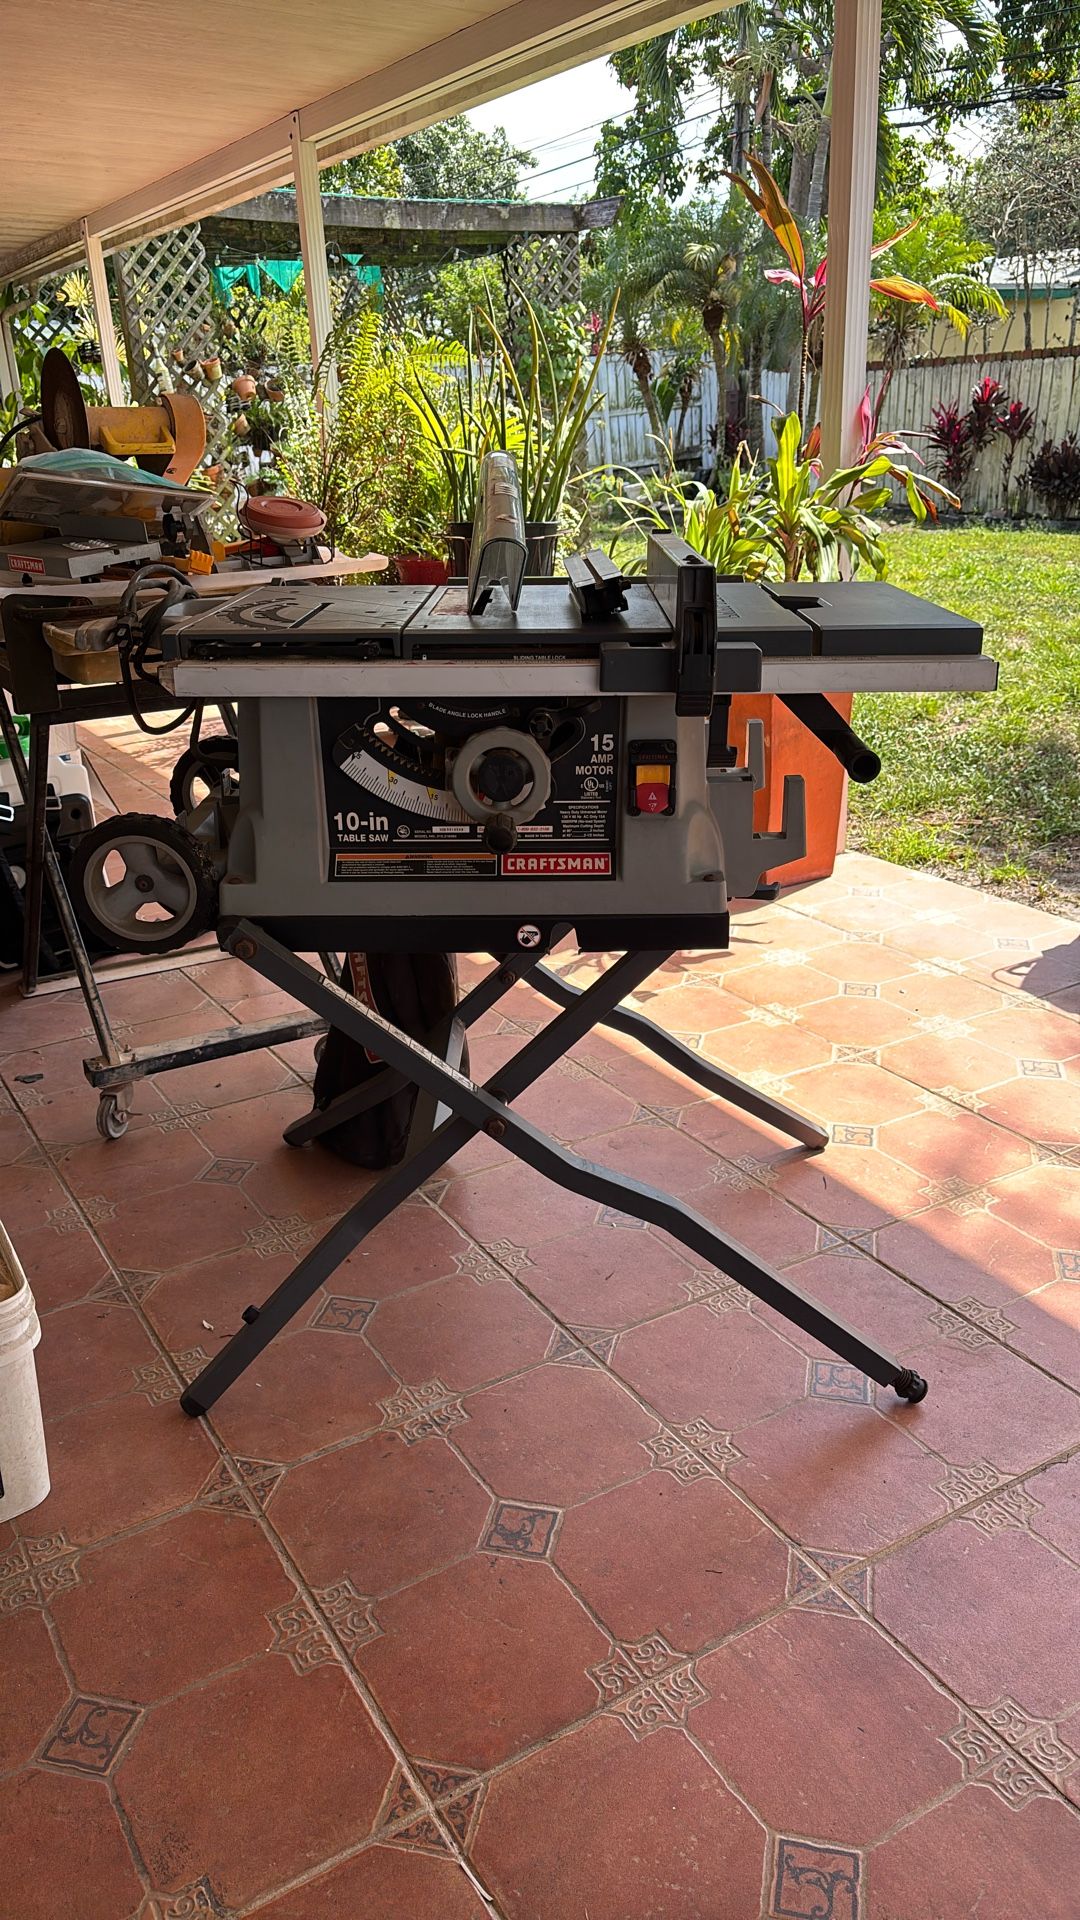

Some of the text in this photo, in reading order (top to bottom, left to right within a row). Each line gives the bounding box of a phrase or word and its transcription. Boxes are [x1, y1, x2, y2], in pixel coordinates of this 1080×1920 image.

[428, 702, 447, 714] BLADE
[447, 710, 466, 718] ANGLE
[483, 708, 507, 718] HANDLE
[590, 734, 614, 752] 15
[590, 754, 614, 763] AMP
[575, 766, 614, 775] MOTOR
[389, 776, 398, 785] 30
[431, 793, 439, 801] 15
[333, 812, 389, 831] 10-in
[337, 834, 389, 842] TABLE SAW
[507, 857, 606, 871] CRAFTSMAN
